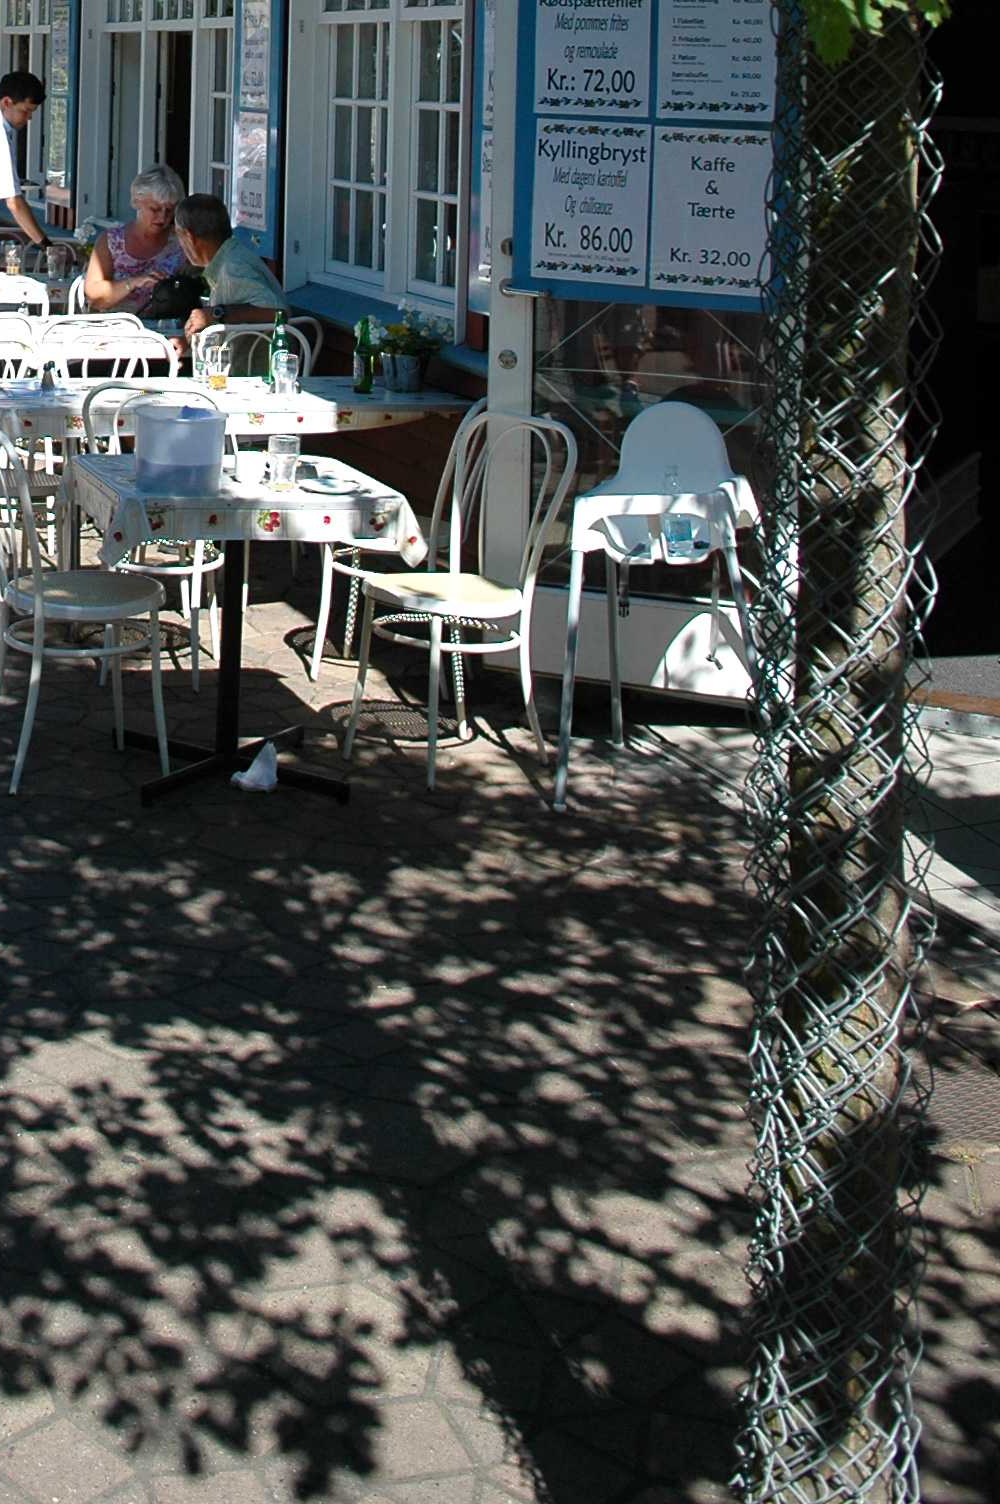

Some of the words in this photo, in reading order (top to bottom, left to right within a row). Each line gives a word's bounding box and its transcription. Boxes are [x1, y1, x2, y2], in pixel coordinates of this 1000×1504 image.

[554, 13, 574, 31] Med
[564, 45, 575, 63] og
[547, 67, 576, 91] Kr.:
[583, 68, 636, 94] 72,00
[538, 139, 647, 167] Kyllingbryst
[691, 155, 736, 172] Kaffe
[553, 166, 571, 184] Med
[705, 180, 720, 195] &
[565, 194, 577, 218] Og
[687, 202, 736, 219] Tærte
[545, 222, 567, 248] Kr.
[580, 224, 633, 253] 86.00
[670, 247, 692, 263] Kr.
